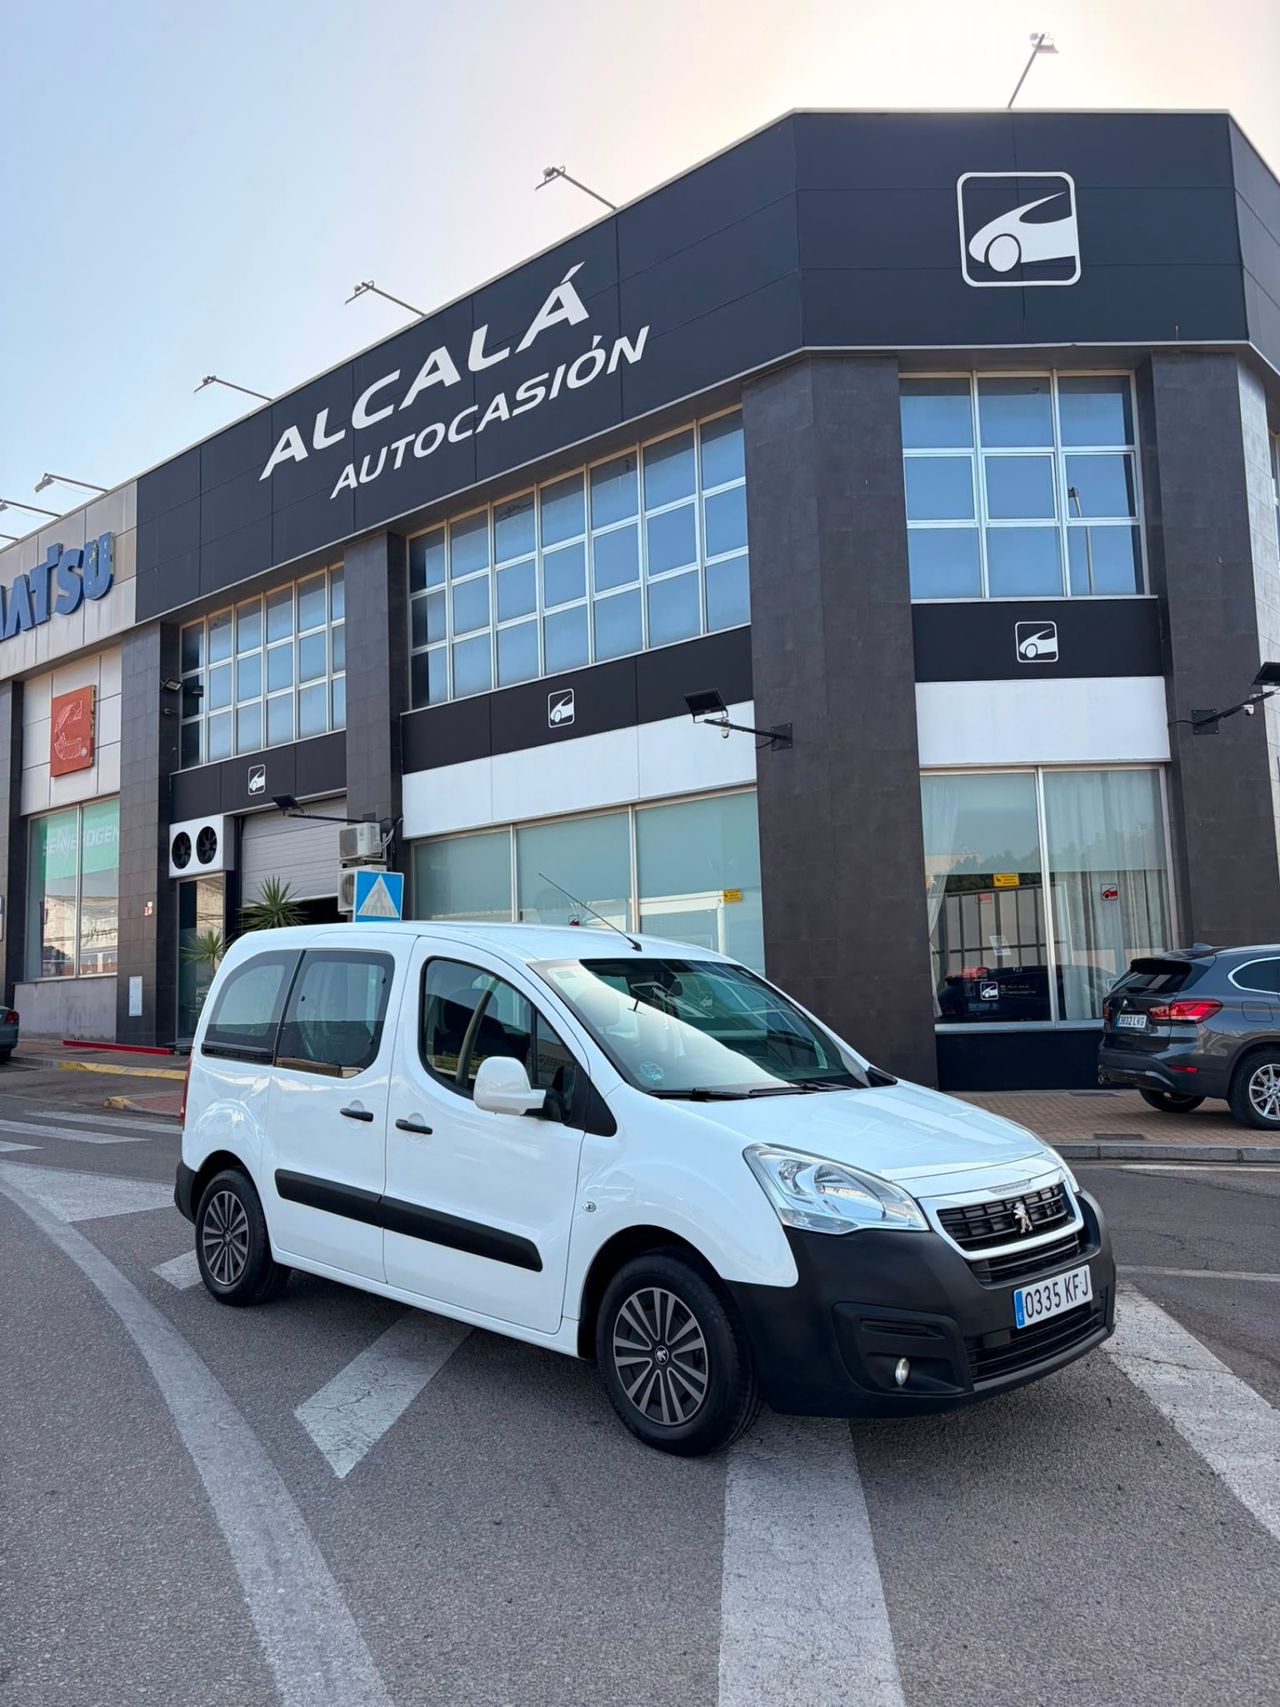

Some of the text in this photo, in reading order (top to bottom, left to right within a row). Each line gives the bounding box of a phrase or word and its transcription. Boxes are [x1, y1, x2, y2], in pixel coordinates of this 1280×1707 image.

[258, 261, 590, 482] ALCALÁ
[329, 325, 651, 501] AUTOCASIÓN
[0, 531, 115, 642] ATSU
[1025, 1270, 1089, 1318] 0335 KFJ
